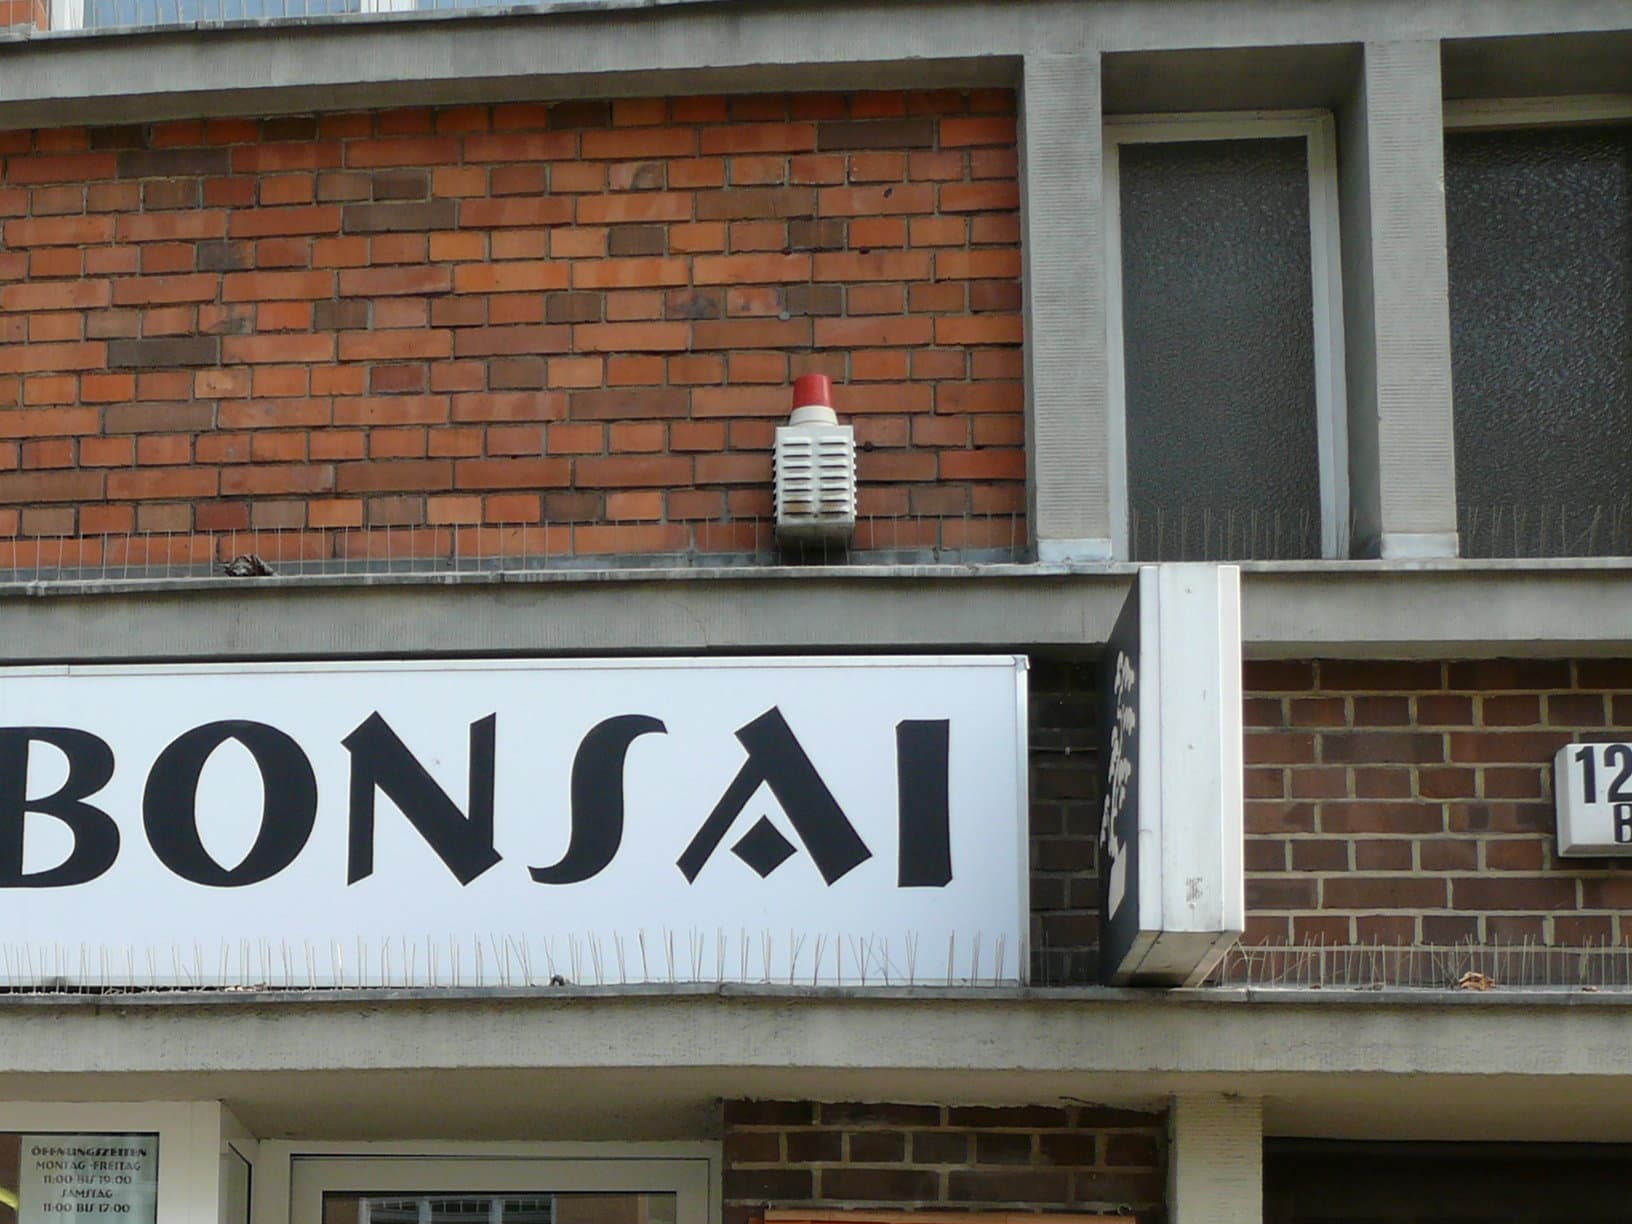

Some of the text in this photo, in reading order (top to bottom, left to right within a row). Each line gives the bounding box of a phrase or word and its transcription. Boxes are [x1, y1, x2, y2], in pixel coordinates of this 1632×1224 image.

[31, 1145, 147, 1157] ÖFFNUNGSZEITEN
[36, 1160, 86, 1171] MONTAG
[77, 1175, 96, 1184] BIS
[61, 1189, 113, 1199] SAMSTAG
[76, 1203, 95, 1213] BIS
[98, 1203, 130, 1213] 17:00
